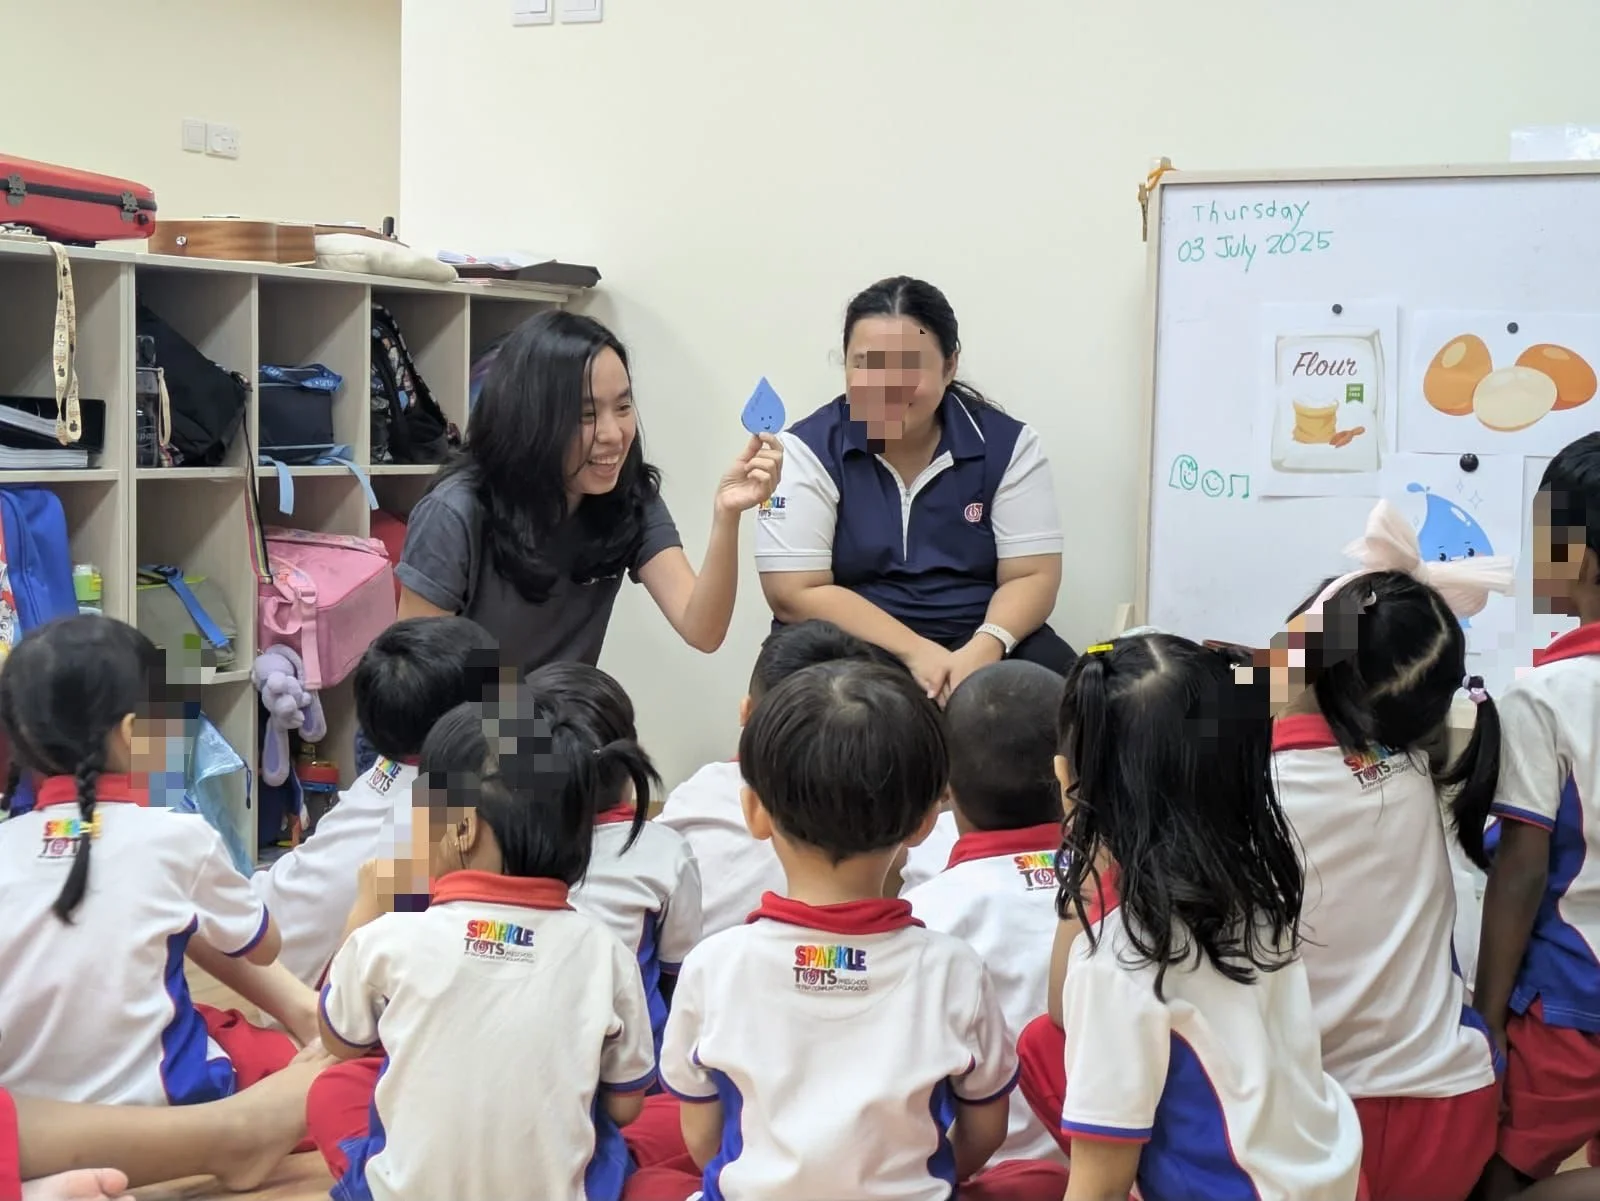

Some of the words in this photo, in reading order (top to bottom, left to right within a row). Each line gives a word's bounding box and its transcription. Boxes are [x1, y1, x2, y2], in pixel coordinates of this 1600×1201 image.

[1193, 200, 1310, 233] Thursday
[1178, 237, 1205, 262] 03
[1216, 234, 1257, 273] July
[1266, 231, 1334, 254] 2025
[1292, 351, 1358, 376] Flour
[1353, 761, 1391, 785] TOTS
[41, 837, 80, 855] TOT
[466, 919, 535, 947] SPARKLE
[464, 937, 505, 956] TOTS
[794, 945, 867, 971] SPARKLE
[793, 967, 838, 986] TOTS
